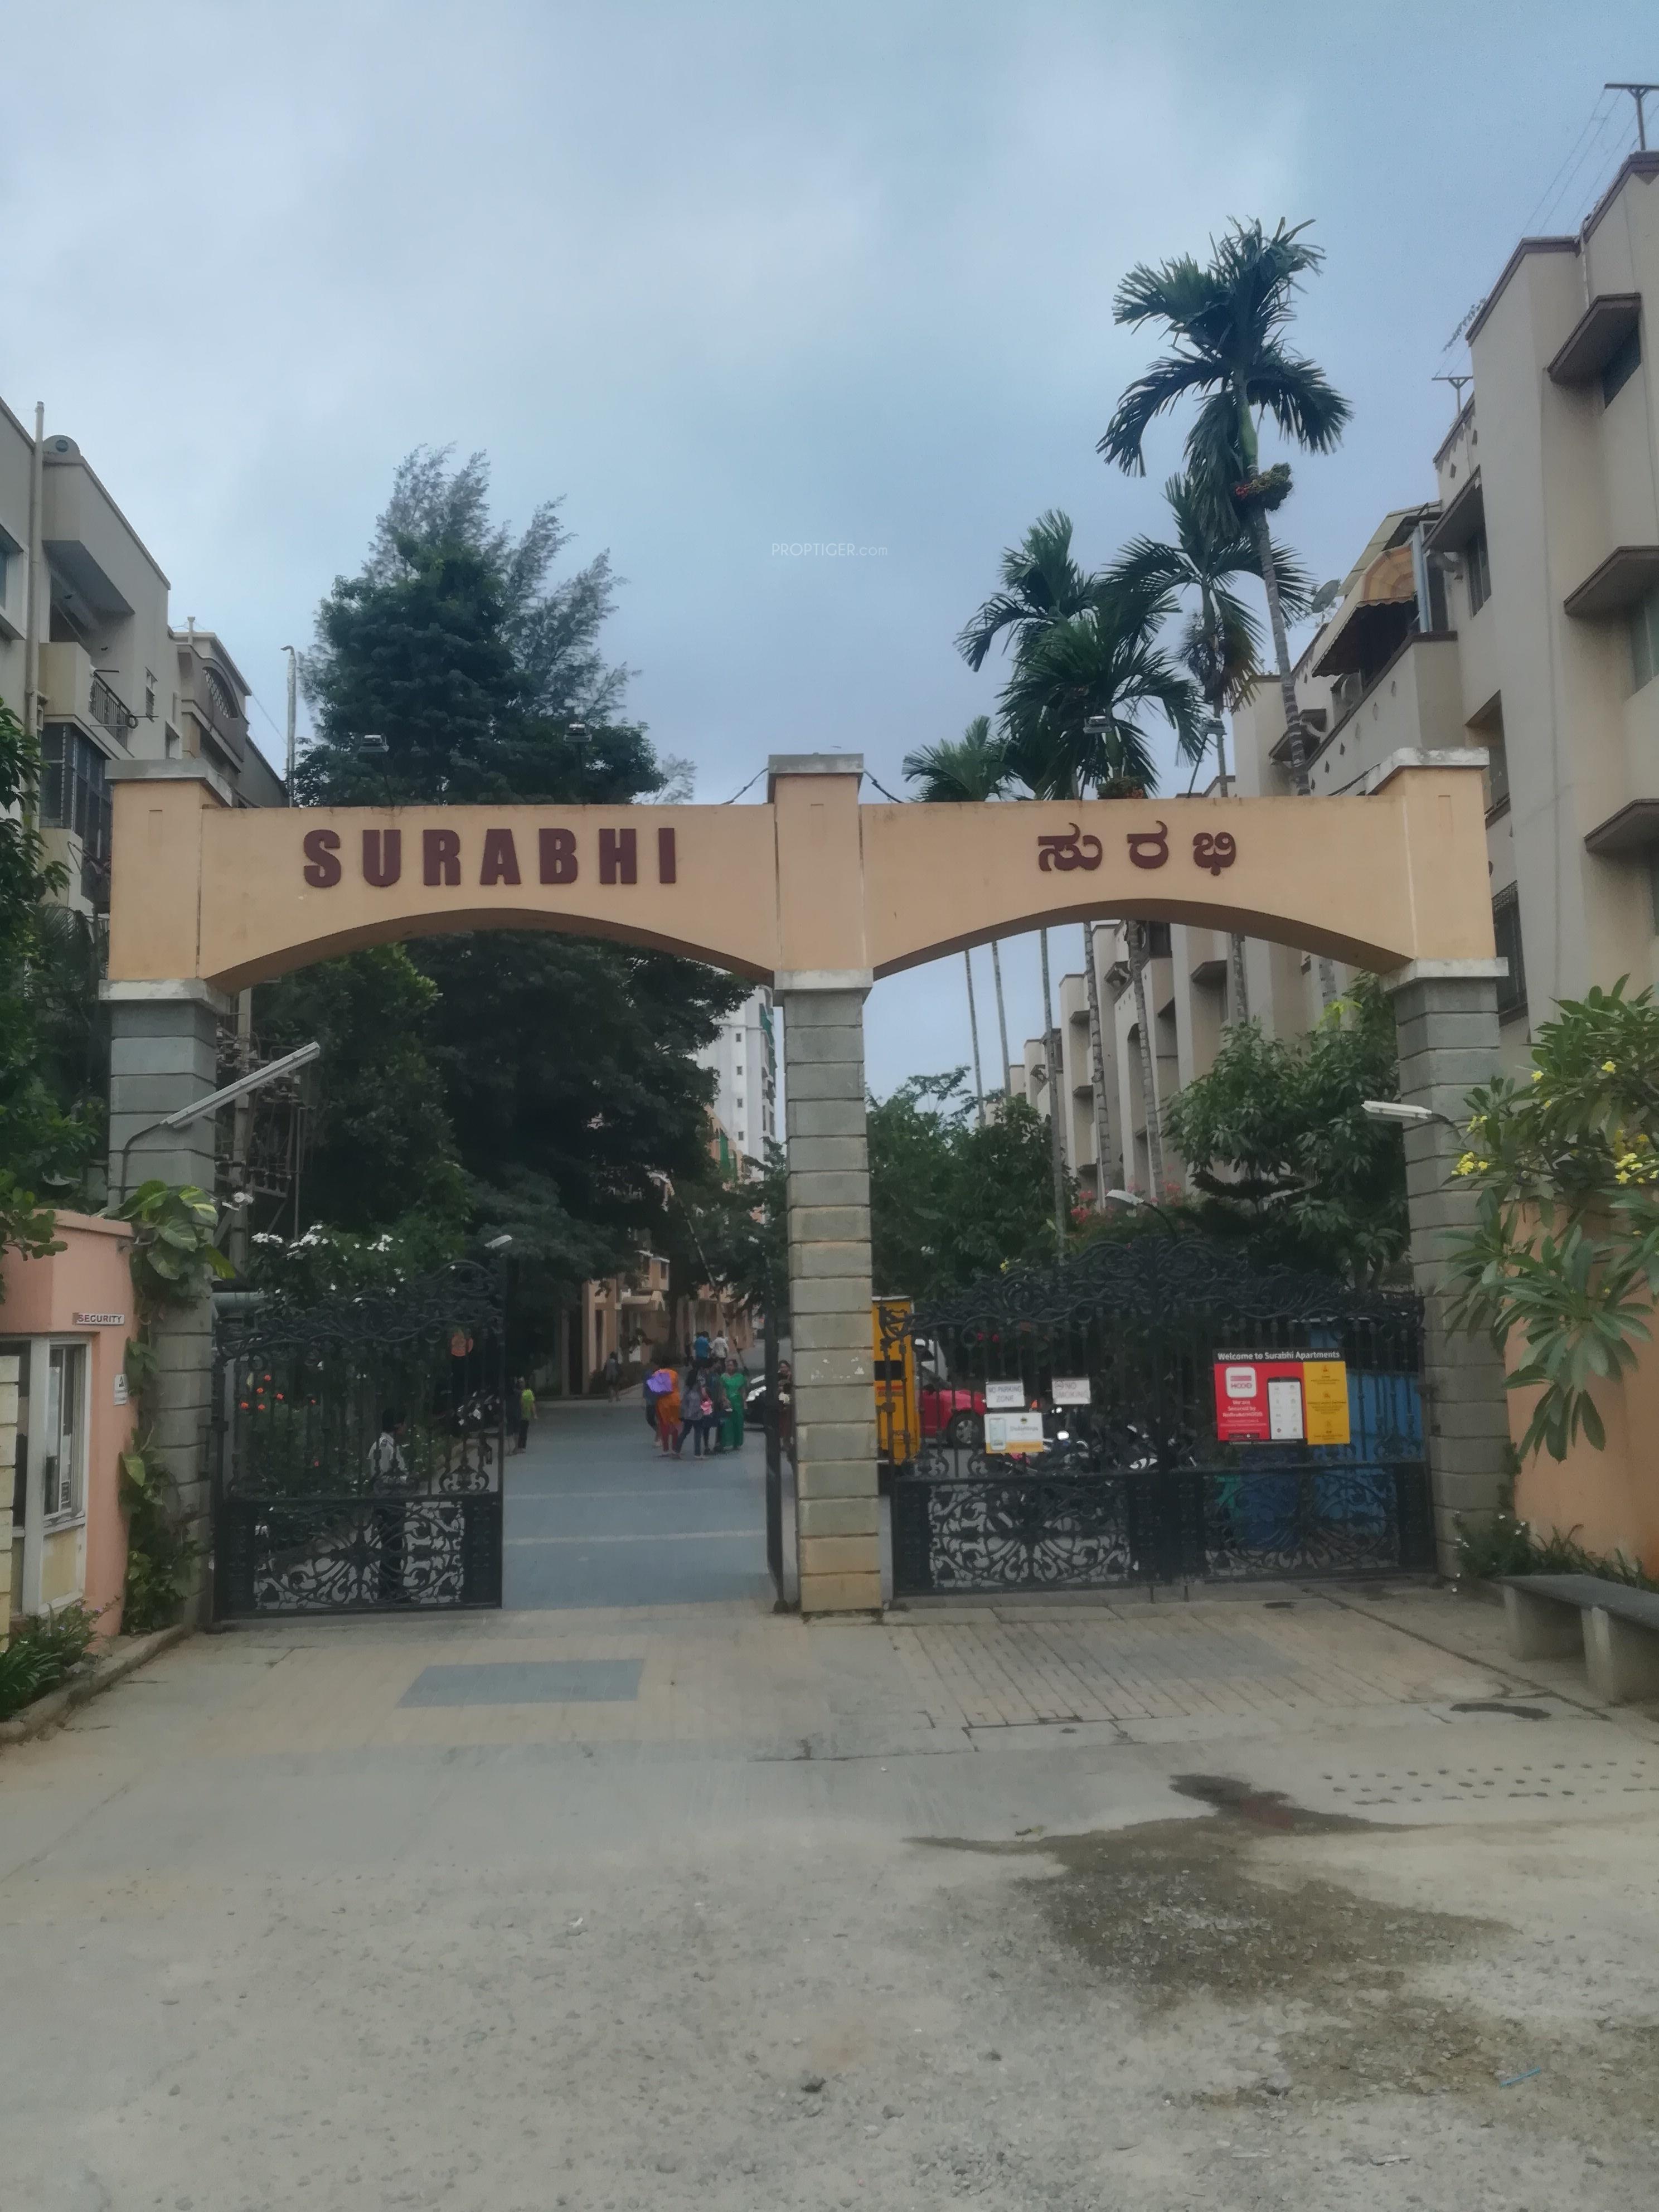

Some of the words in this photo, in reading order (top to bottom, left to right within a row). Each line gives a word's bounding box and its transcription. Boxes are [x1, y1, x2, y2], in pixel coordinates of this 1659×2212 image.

[304, 828, 676, 888] SURABHI
[1037, 820, 1236, 876] ಸುರಭಿ
[78, 1314, 122, 1323] SECURITY
[1265, 1351, 1294, 1360] Surabhi
[1296, 1351, 1340, 1360] Apartments
